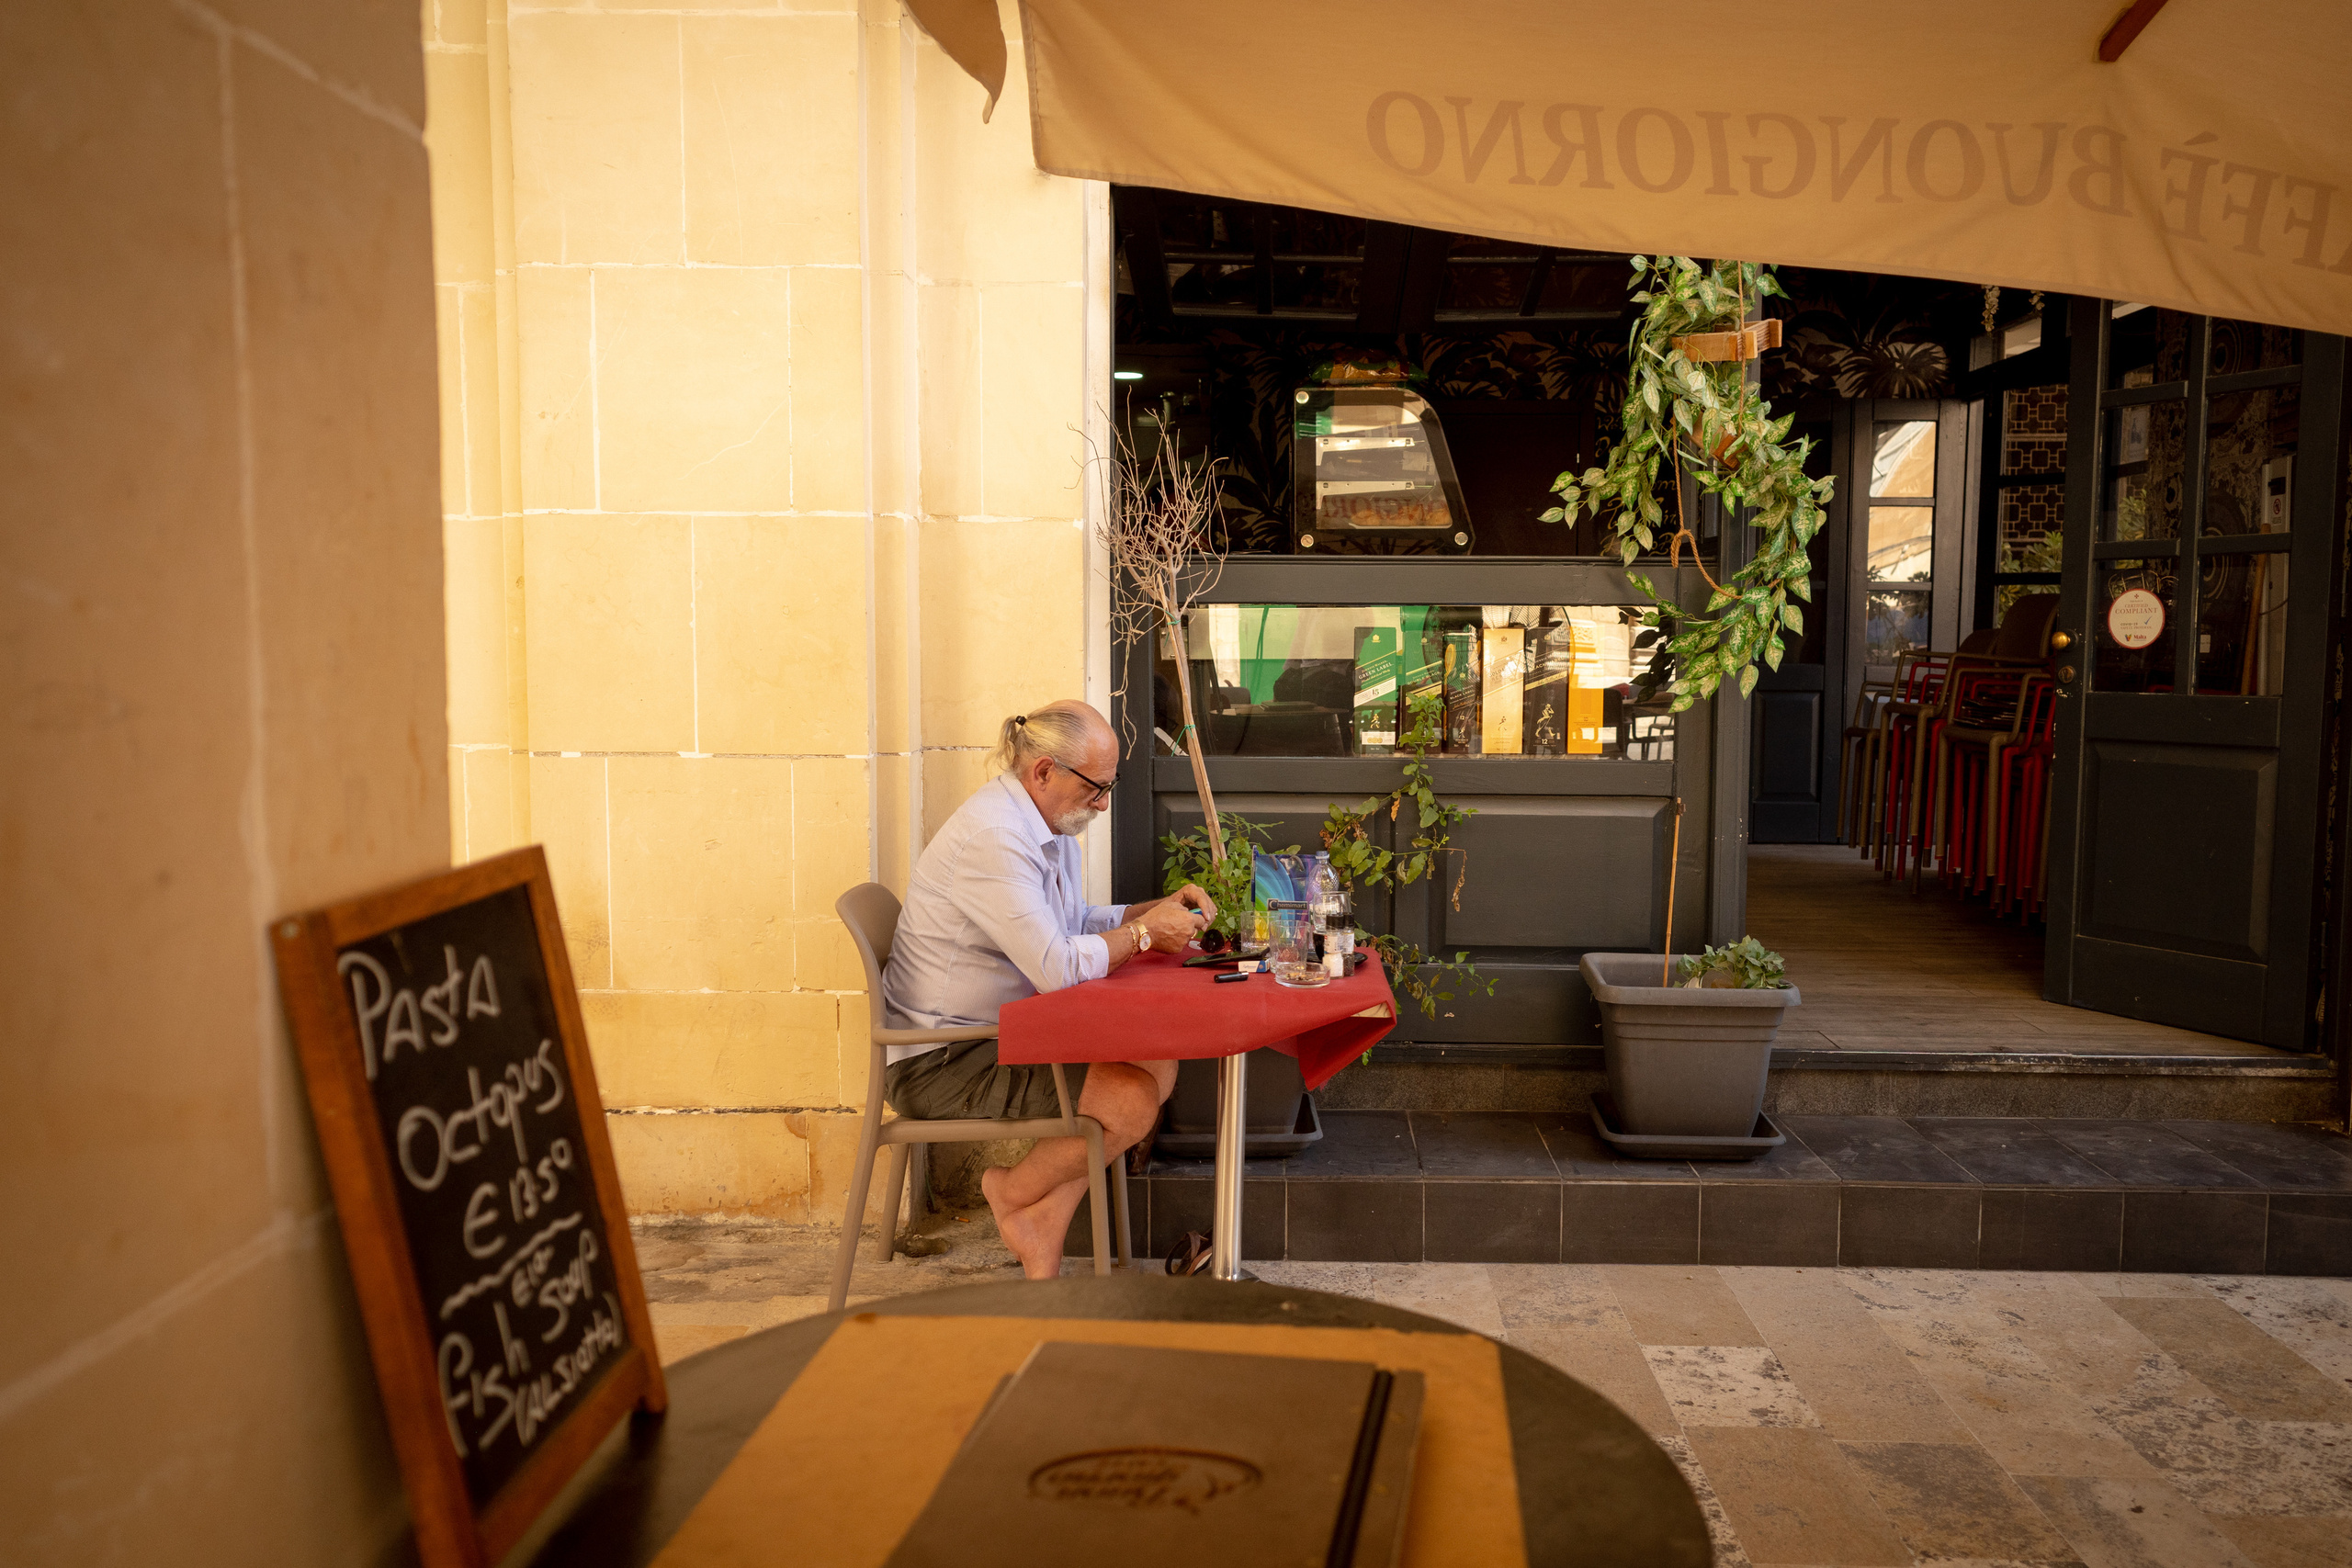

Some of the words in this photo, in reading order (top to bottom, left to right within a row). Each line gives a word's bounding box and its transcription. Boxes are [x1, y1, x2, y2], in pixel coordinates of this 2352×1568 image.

[1358, 669, 1376, 680] GREEN
[1376, 661, 1393, 672] LABEL
[1269, 900, 1306, 909] Chemimart
